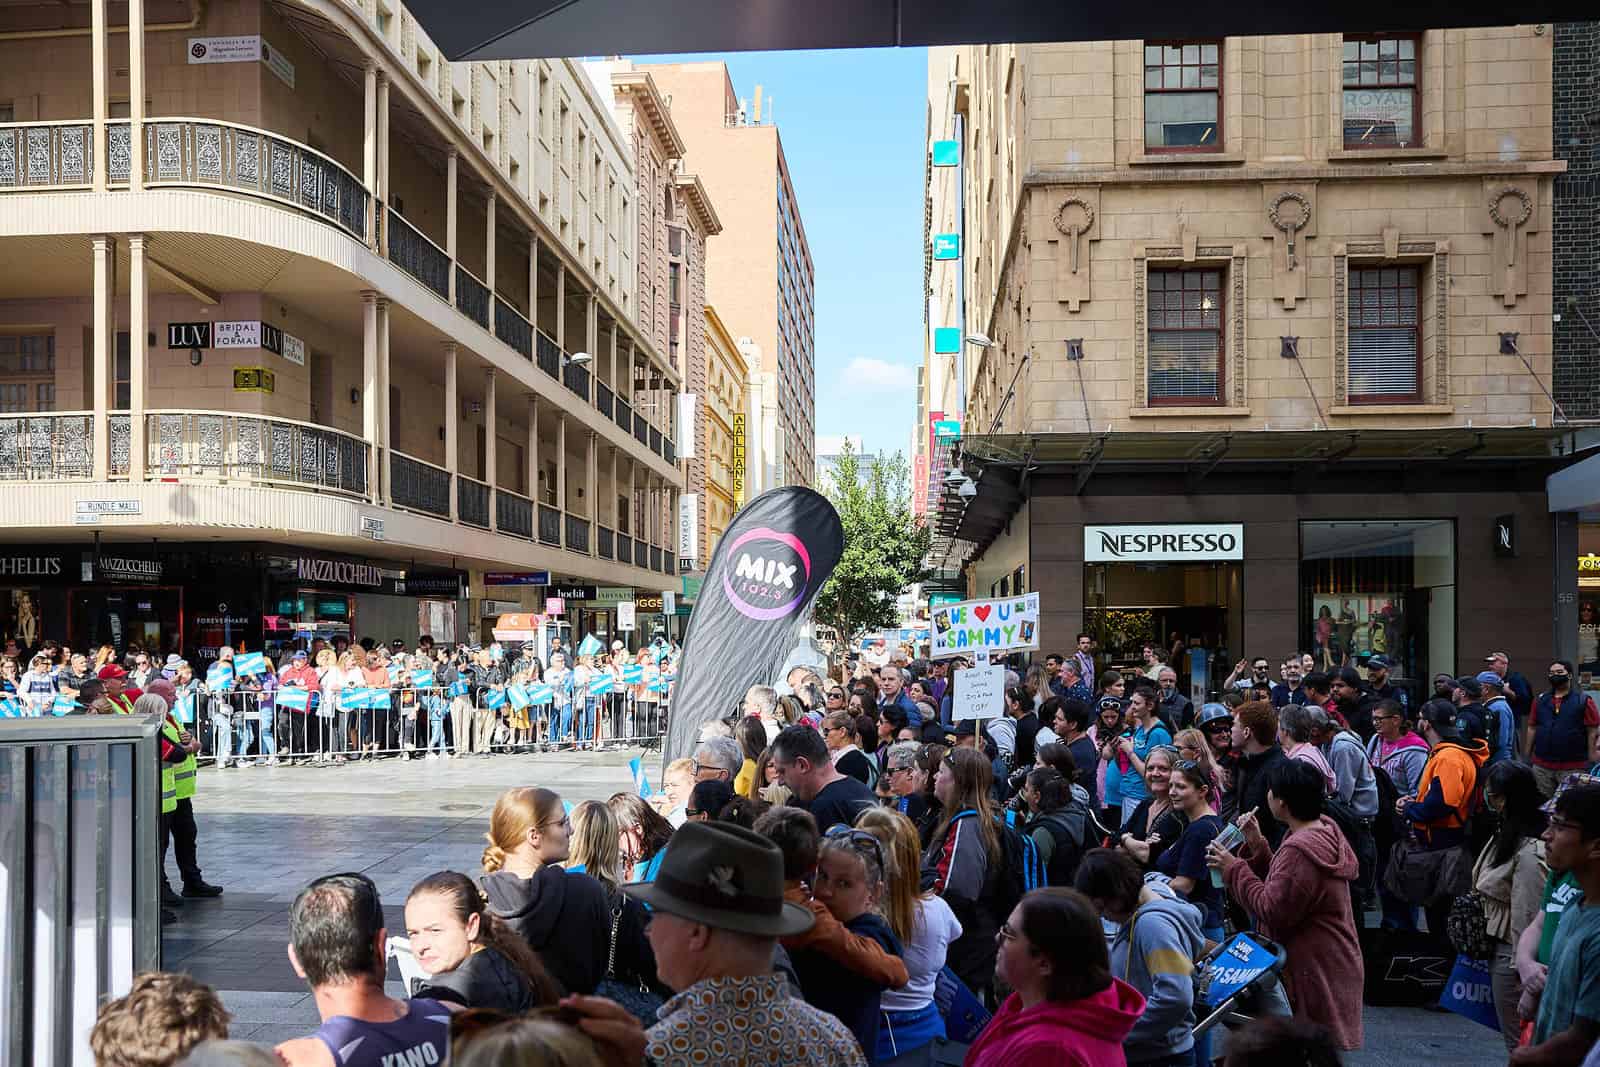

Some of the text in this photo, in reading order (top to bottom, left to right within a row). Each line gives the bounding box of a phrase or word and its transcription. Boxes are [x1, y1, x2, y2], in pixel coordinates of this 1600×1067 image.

[1344, 91, 1408, 105] ROYAL
[170, 325, 208, 346] LUV
[219, 323, 256, 332] BRIDAL
[216, 336, 258, 345] FORMAL
[735, 426, 743, 490] ALLANS
[88, 502, 136, 511] RUNDLE MALL
[1096, 530, 1236, 557] NESPRESSO
[0, 557, 61, 575] HELLI'S
[736, 553, 797, 589] MIX
[951, 606, 968, 625] WE
[998, 603, 1010, 621] U
[947, 624, 1016, 649] SAMMY
